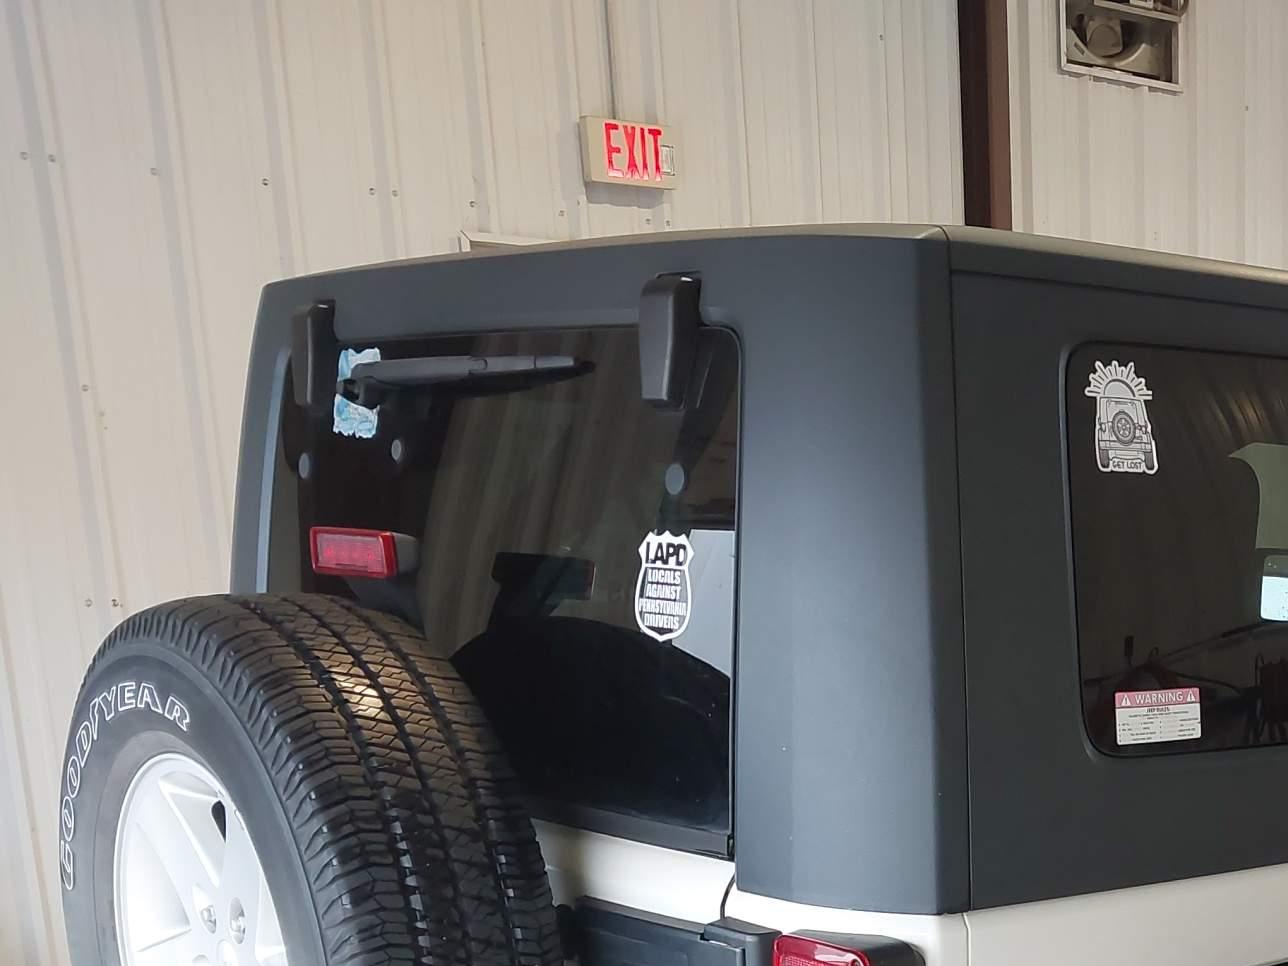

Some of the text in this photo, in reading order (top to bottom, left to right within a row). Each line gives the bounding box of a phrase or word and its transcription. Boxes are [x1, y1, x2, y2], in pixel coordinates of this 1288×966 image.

[604, 121, 662, 181] EXIT
[1112, 460, 1142, 470] GET LOST
[645, 541, 687, 566] LAPD
[646, 568, 681, 584] LOCALS
[645, 583, 682, 600] AGAINST
[639, 598, 687, 616] PENNSYLVANIA
[643, 613, 680, 630] DRIVERS
[1134, 691, 1184, 705] WARNING
[60, 681, 191, 890] GOODYEAR
